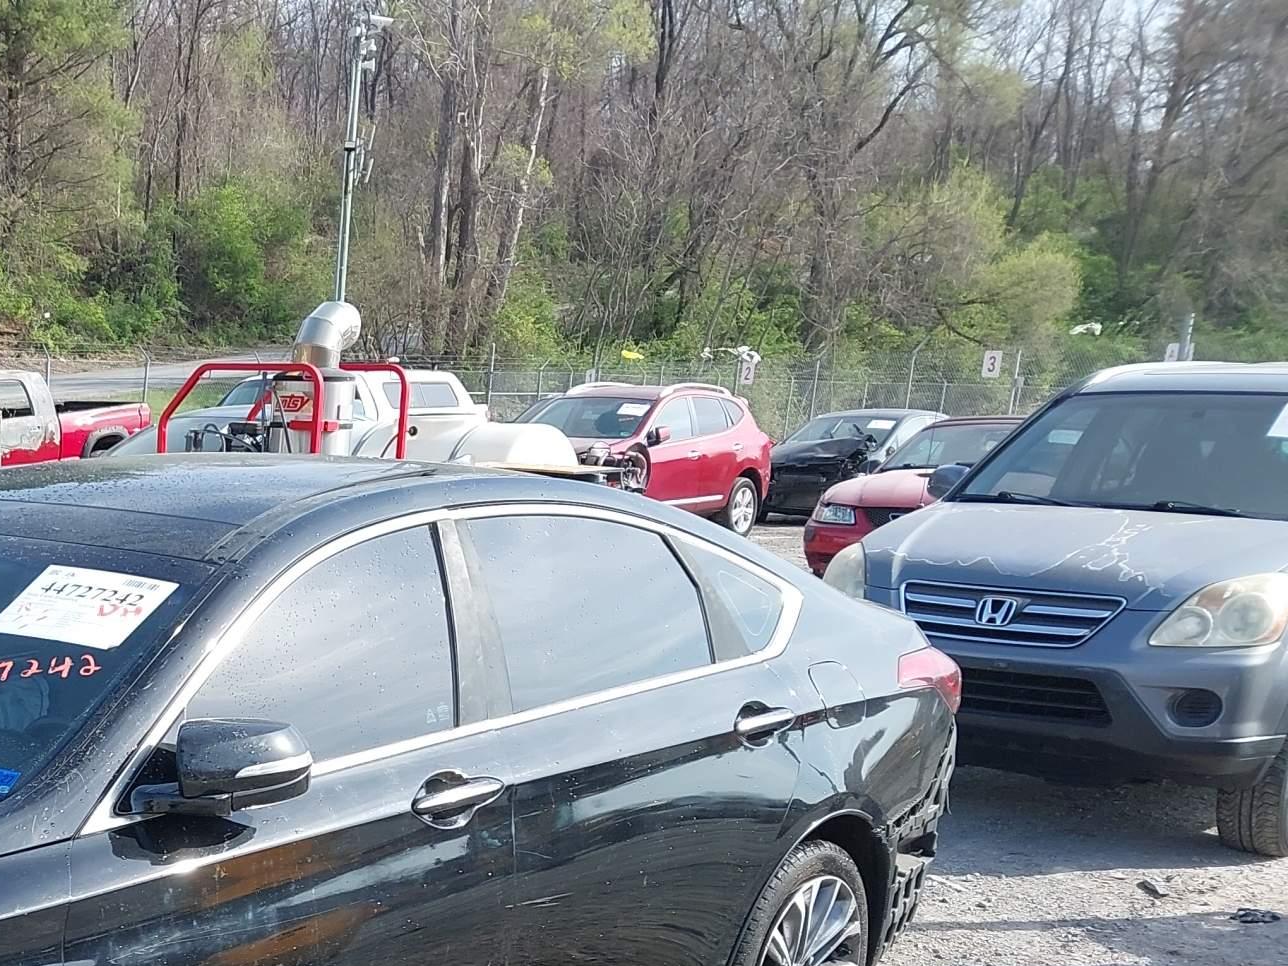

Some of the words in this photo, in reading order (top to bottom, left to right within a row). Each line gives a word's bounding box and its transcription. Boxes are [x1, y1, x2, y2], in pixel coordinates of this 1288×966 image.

[987, 355, 997, 372] 3
[744, 366, 752, 380] 2
[41, 581, 145, 607] 44727242
